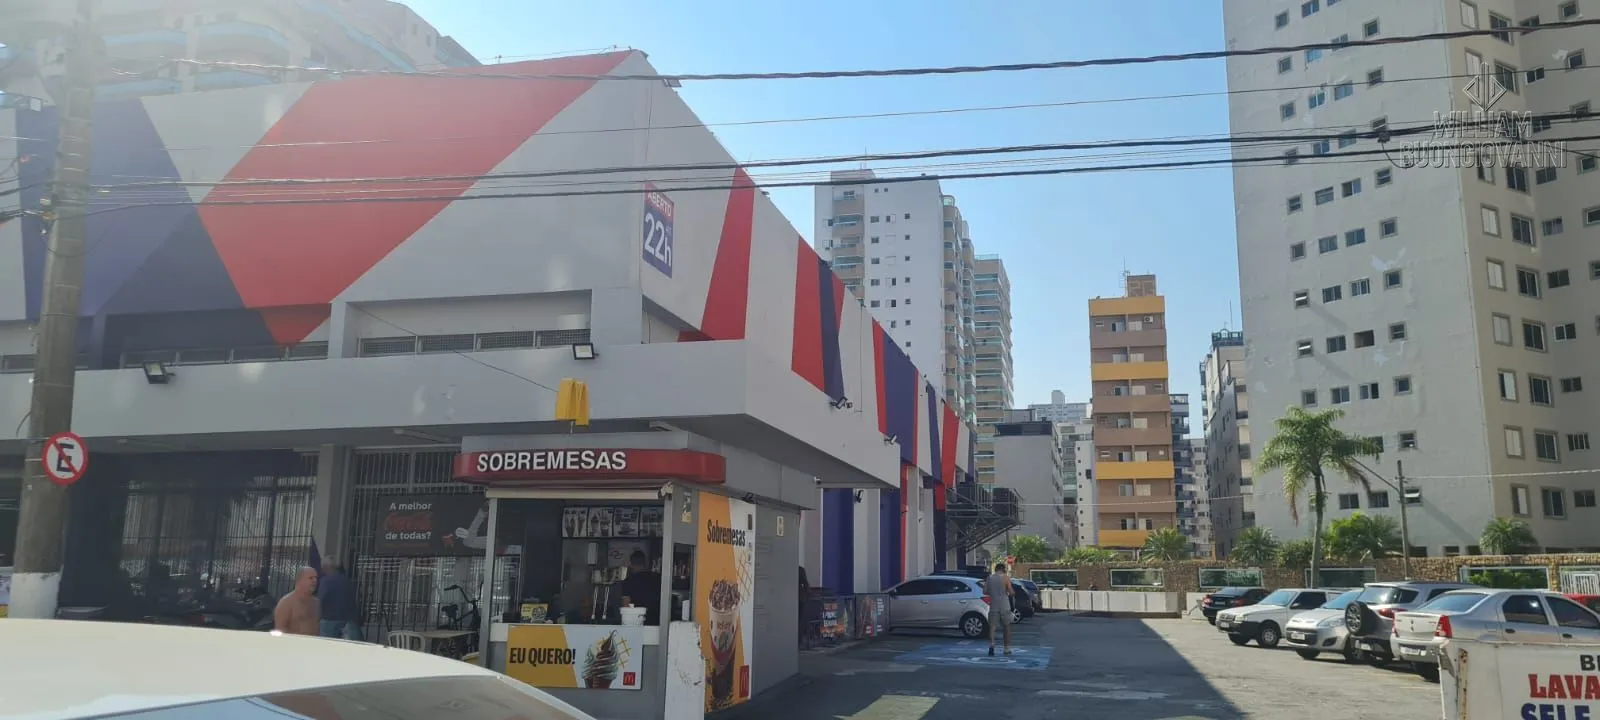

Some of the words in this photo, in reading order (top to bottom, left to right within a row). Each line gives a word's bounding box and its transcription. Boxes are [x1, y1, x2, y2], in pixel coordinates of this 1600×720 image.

[647, 190, 672, 217] ABERTO
[644, 212, 672, 268] 22h
[476, 449, 627, 472] SOBREMESAS
[389, 502, 397, 511] A
[398, 501, 433, 511] melhor
[385, 531, 398, 540] de
[400, 531, 432, 541] todas?
[706, 518, 746, 548] Sobremesas
[509, 647, 526, 664] EU
[528, 647, 577, 667] QUERO!
